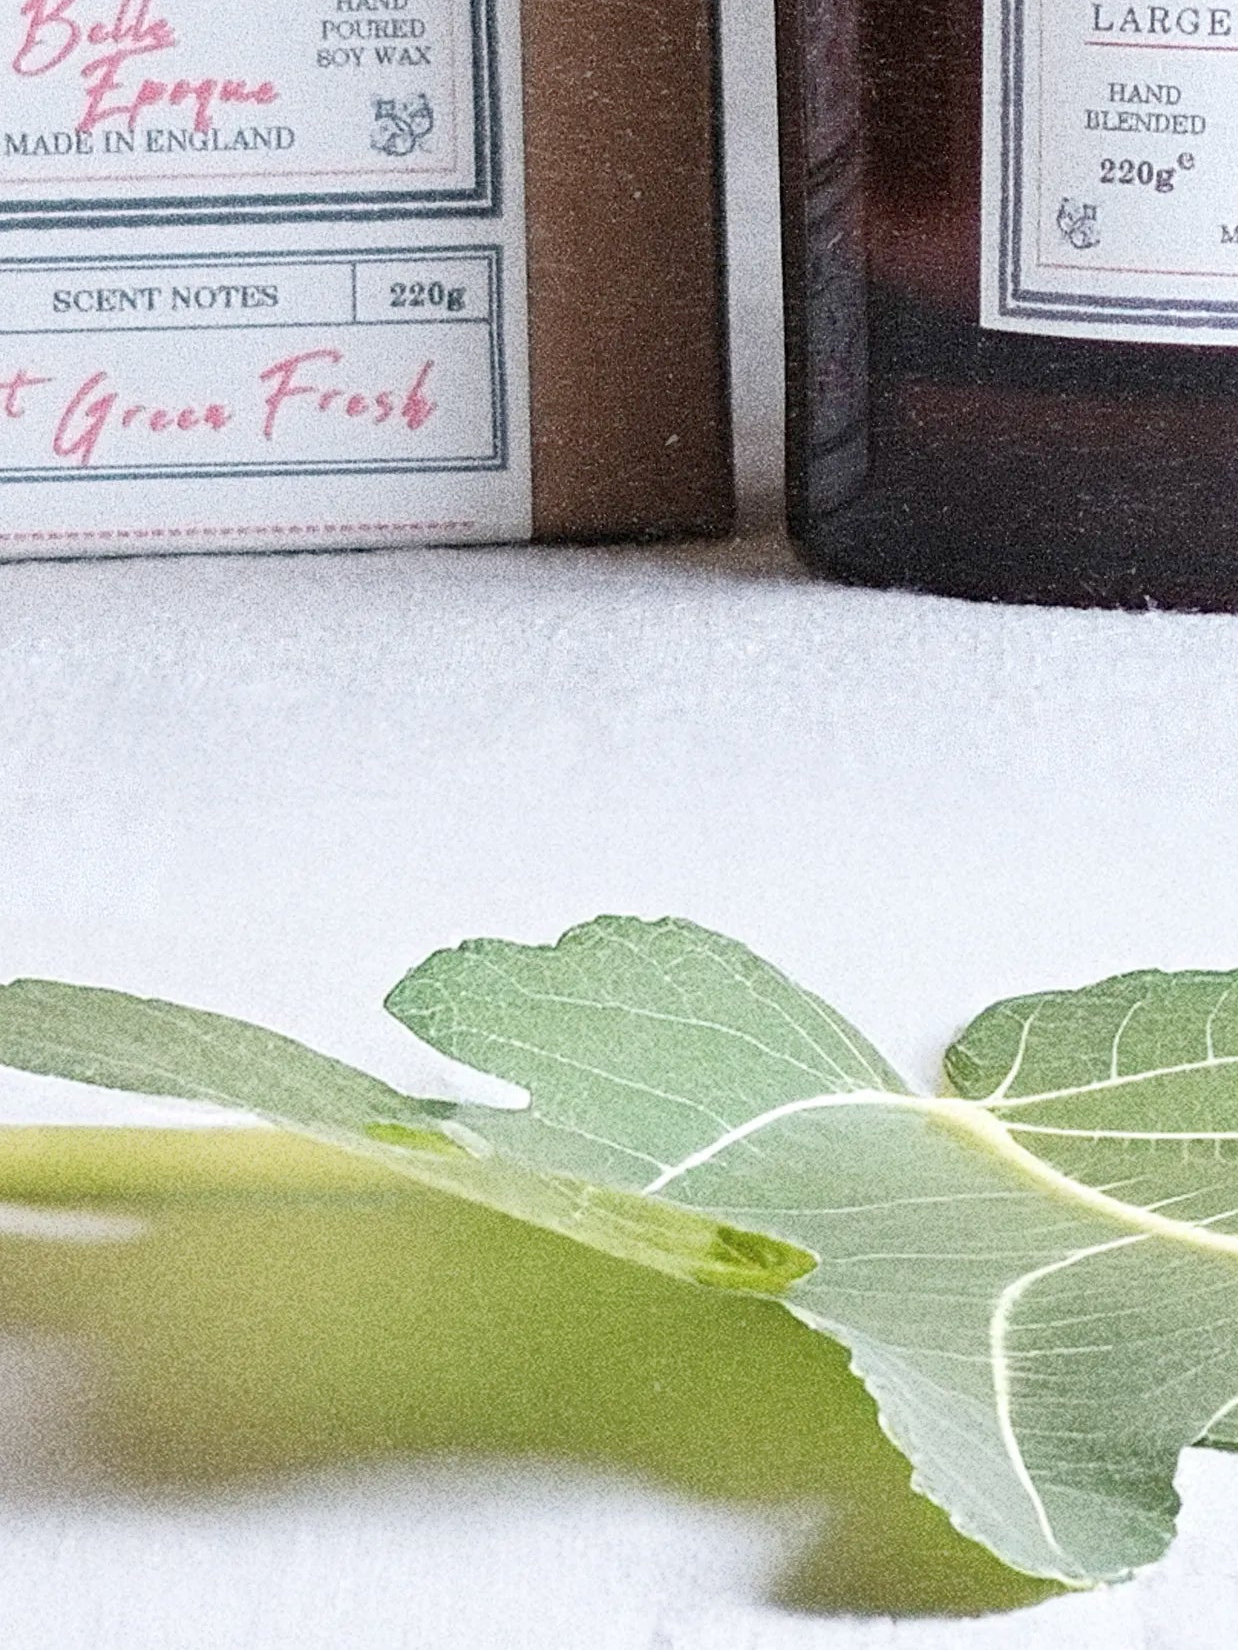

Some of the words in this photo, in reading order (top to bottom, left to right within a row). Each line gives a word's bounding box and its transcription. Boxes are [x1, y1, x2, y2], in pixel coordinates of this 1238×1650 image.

[321, 17, 427, 40] POURED
[1091, 2, 1232, 37] LARGE
[316, 46, 366, 69] SOY
[375, 45, 432, 67] WAX
[1107, 81, 1182, 106] HAND
[1083, 108, 1207, 136] BLENDED
[4, 128, 94, 157] MADE
[104, 128, 135, 154] IN
[145, 124, 296, 153] ENGLAND
[52, 288, 162, 313] SCENT
[171, 284, 279, 311] NOTES
[390, 281, 467, 313] 220g
[52, 370, 233, 468] Green
